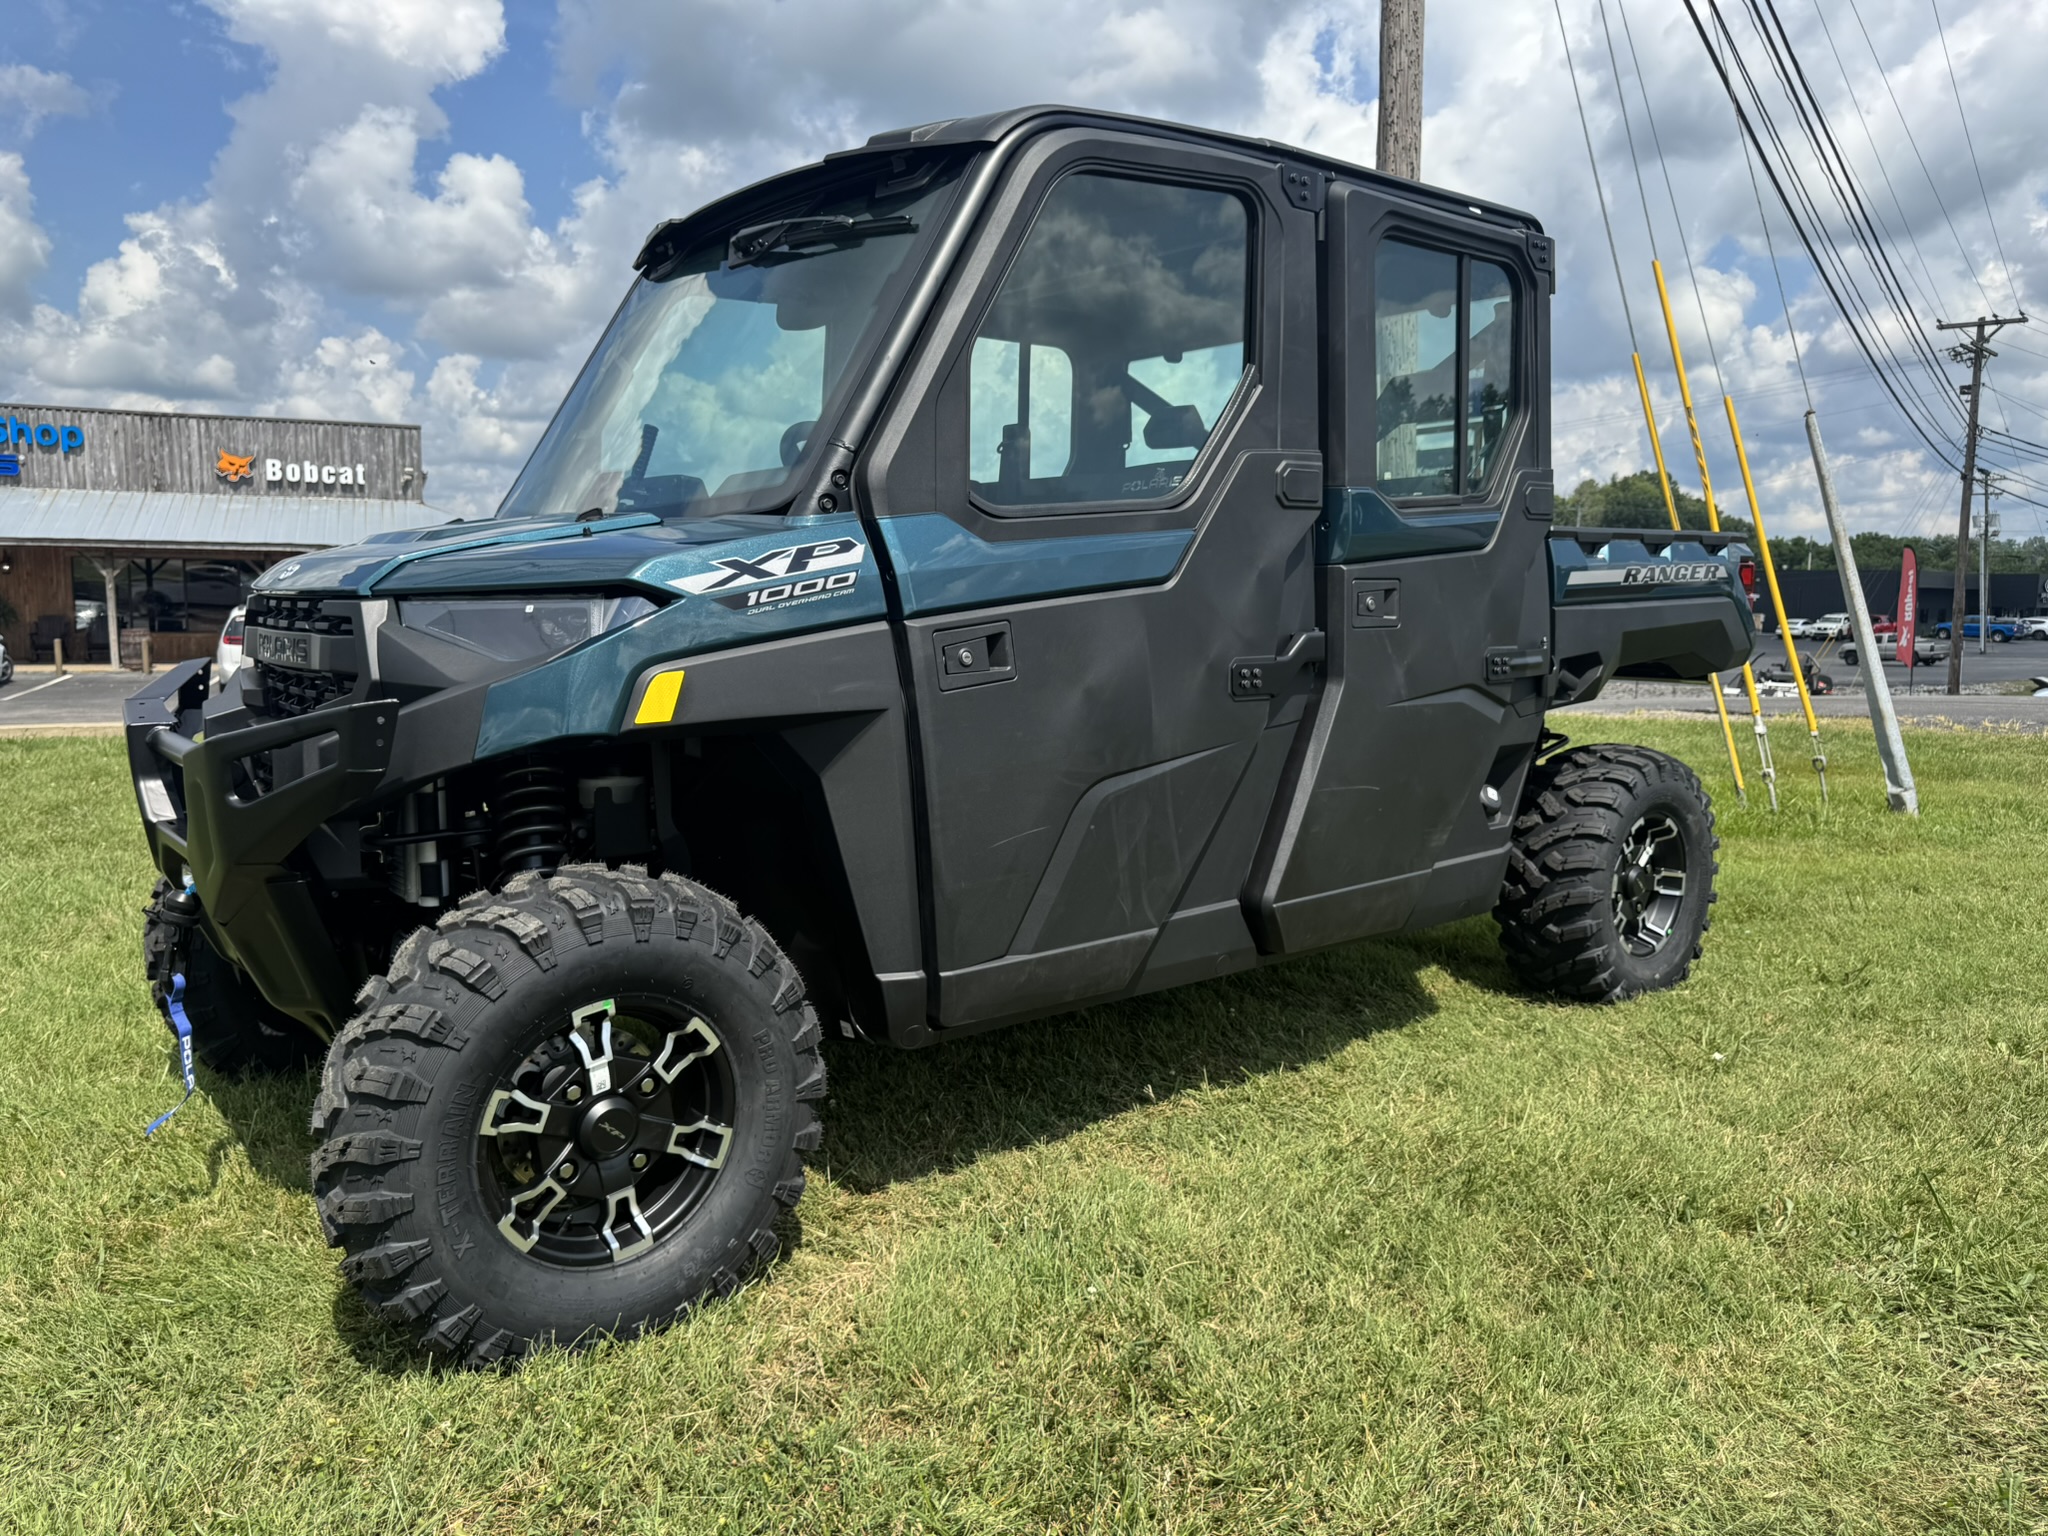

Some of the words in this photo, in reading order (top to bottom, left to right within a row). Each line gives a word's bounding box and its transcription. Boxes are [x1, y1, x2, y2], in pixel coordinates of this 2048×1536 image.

[265, 458, 366, 485] Bobcat
[1122, 475, 1183, 493] POLARIS
[701, 538, 860, 592] XP
[1621, 564, 1720, 585] RANGER
[747, 571, 857, 606] 1000
[747, 605, 775, 615] DUAL
[778, 593, 831, 608] OVERHEAD
[833, 588, 855, 597] CAM
[436, 1081, 478, 1260] X-TERRAIN
